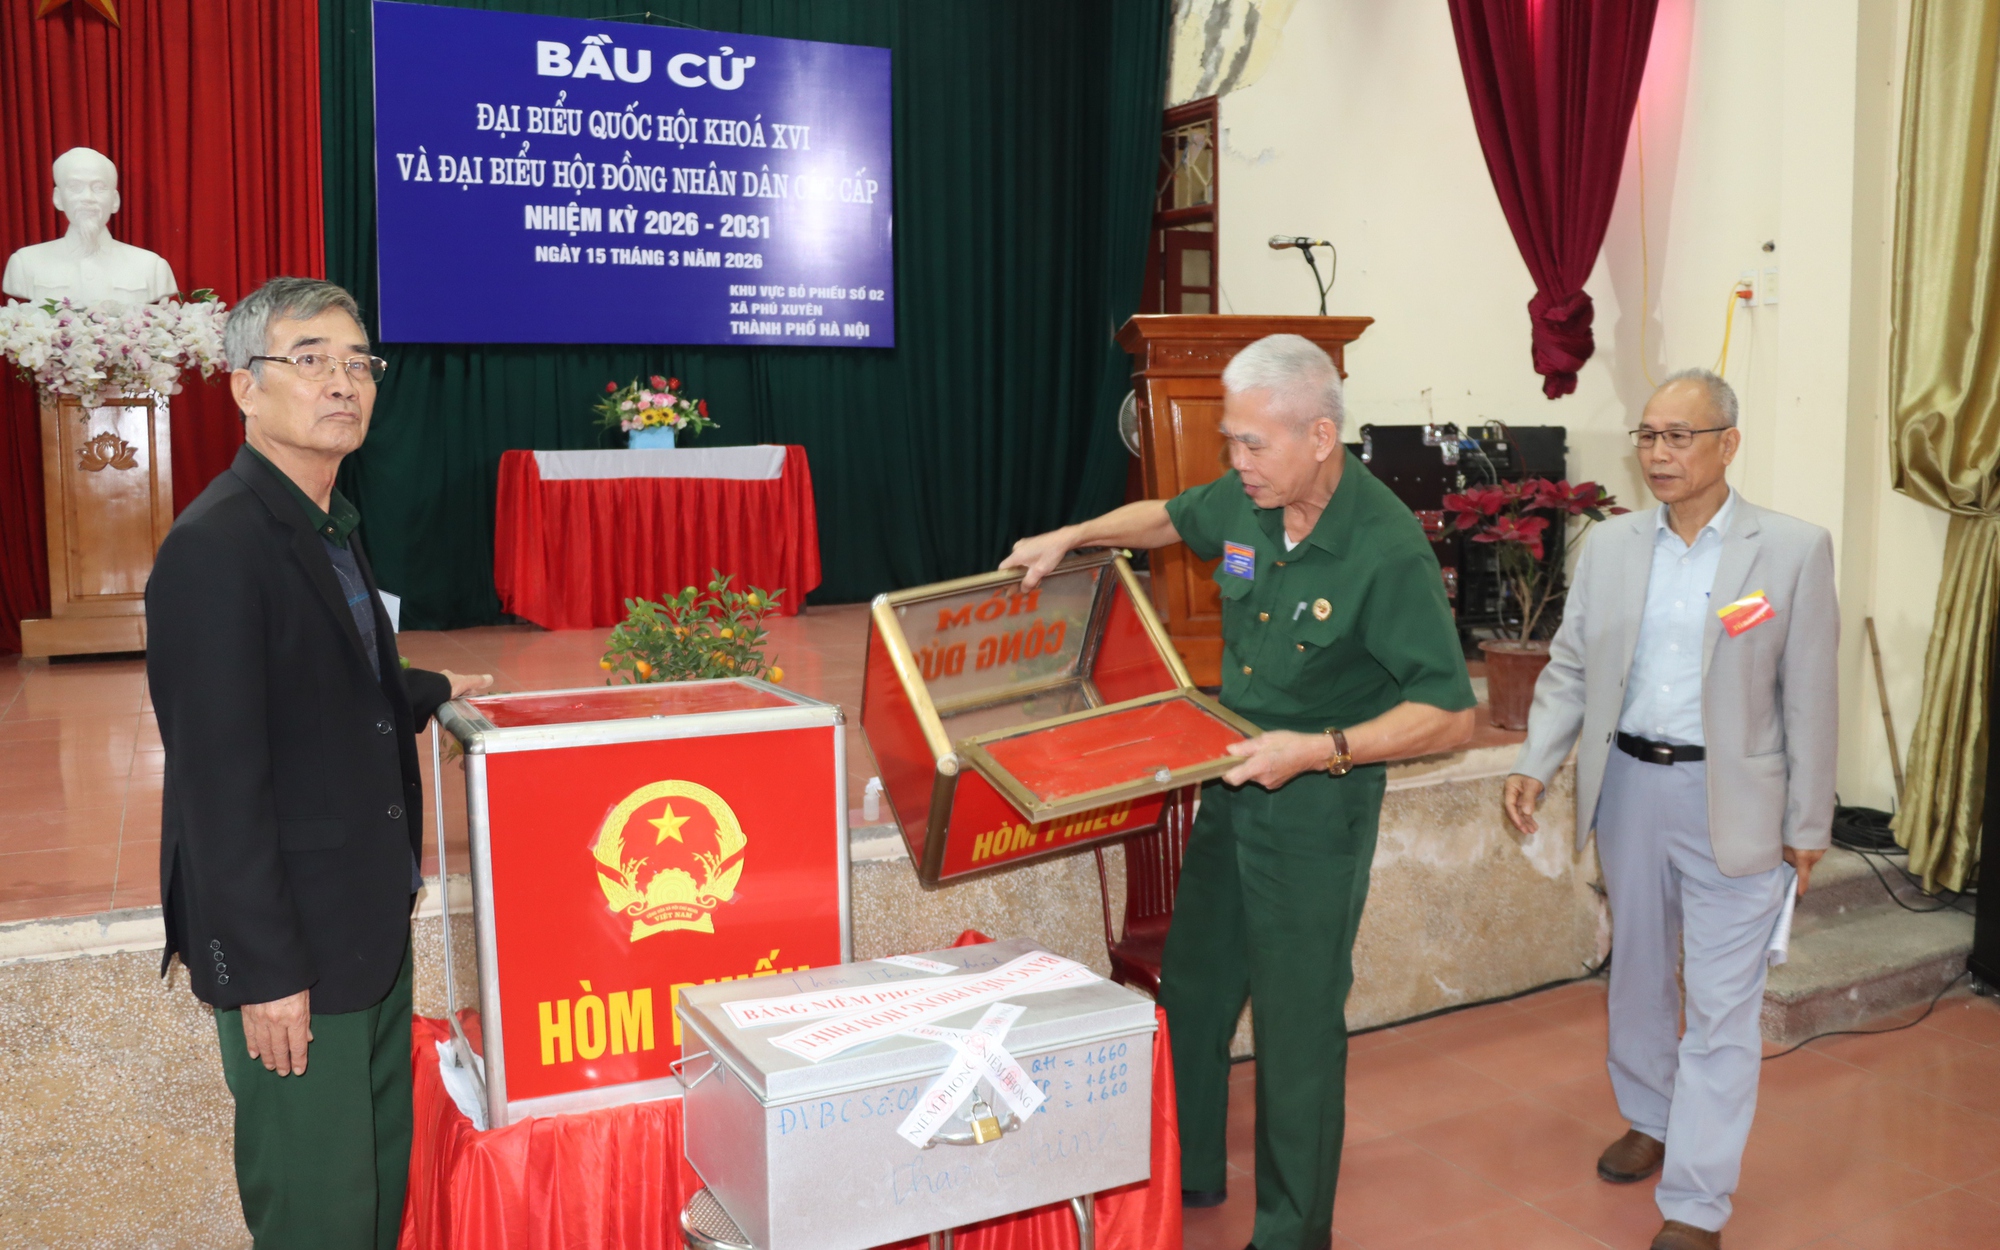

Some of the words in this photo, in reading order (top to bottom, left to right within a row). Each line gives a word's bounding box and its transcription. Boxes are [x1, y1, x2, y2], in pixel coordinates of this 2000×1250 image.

[536, 33, 652, 84] BẦU
[667, 45, 756, 91] CỬ
[476, 102, 521, 139] ĐẠI
[526, 89, 583, 136] BIỂU
[588, 100, 652, 140] QUỐC
[657, 107, 698, 150] HỘI
[703, 113, 766, 148] KHOÁ
[771, 122, 811, 150] XVI
[396, 145, 433, 182] VÀ
[438, 155, 483, 191] ĐẠI
[489, 140, 547, 187] BIỂU
[552, 152, 596, 196] HỘI
[601, 150, 667, 193] ĐỒNG
[672, 160, 737, 196] NHÂN
[742, 164, 789, 199] DÂN
[839, 166, 879, 204] CẤP
[524, 201, 602, 236] NHIỆM
[608, 204, 638, 233] KỲ
[644, 210, 699, 236] 2026
[704, 222, 714, 230] -
[720, 213, 770, 239] 2031
[535, 243, 581, 263] NGÀY
[586, 247, 606, 264] 15
[610, 246, 665, 266] THÁNG
[668, 250, 679, 266] 3
[683, 248, 721, 267] NĂM
[724, 252, 763, 268] 2026
[730, 284, 756, 297] KHU
[760, 284, 785, 299] VỰC
[788, 284, 806, 298] BỎ
[809, 285, 846, 299] PHIẾU
[850, 286, 866, 300] SỐ
[869, 289, 885, 301] 02
[730, 301, 748, 314] XÃ
[752, 302, 778, 315] PHÚ
[781, 303, 823, 316] XUYÊN
[730, 319, 782, 335] THÀNH
[785, 318, 816, 336] PHỐ
[820, 321, 840, 336] HÀ
[844, 321, 870, 340] NỘI
[971, 821, 1040, 862] HÒM
[742, 1001, 809, 1021] BĂNG
[812, 995, 871, 1014] NIÊM
[901, 986, 964, 1016] PHONG
[538, 979, 655, 1066] HÒM
[1085, 1043, 1127, 1066] 1.660
[982, 1046, 1006, 1076] NIÊM
[1003, 1072, 1033, 1109] PHONG
[1086, 1063, 1127, 1087] 1.660
[1087, 1081, 1127, 1104] 1.660
[909, 1103, 941, 1139] NIÊM
